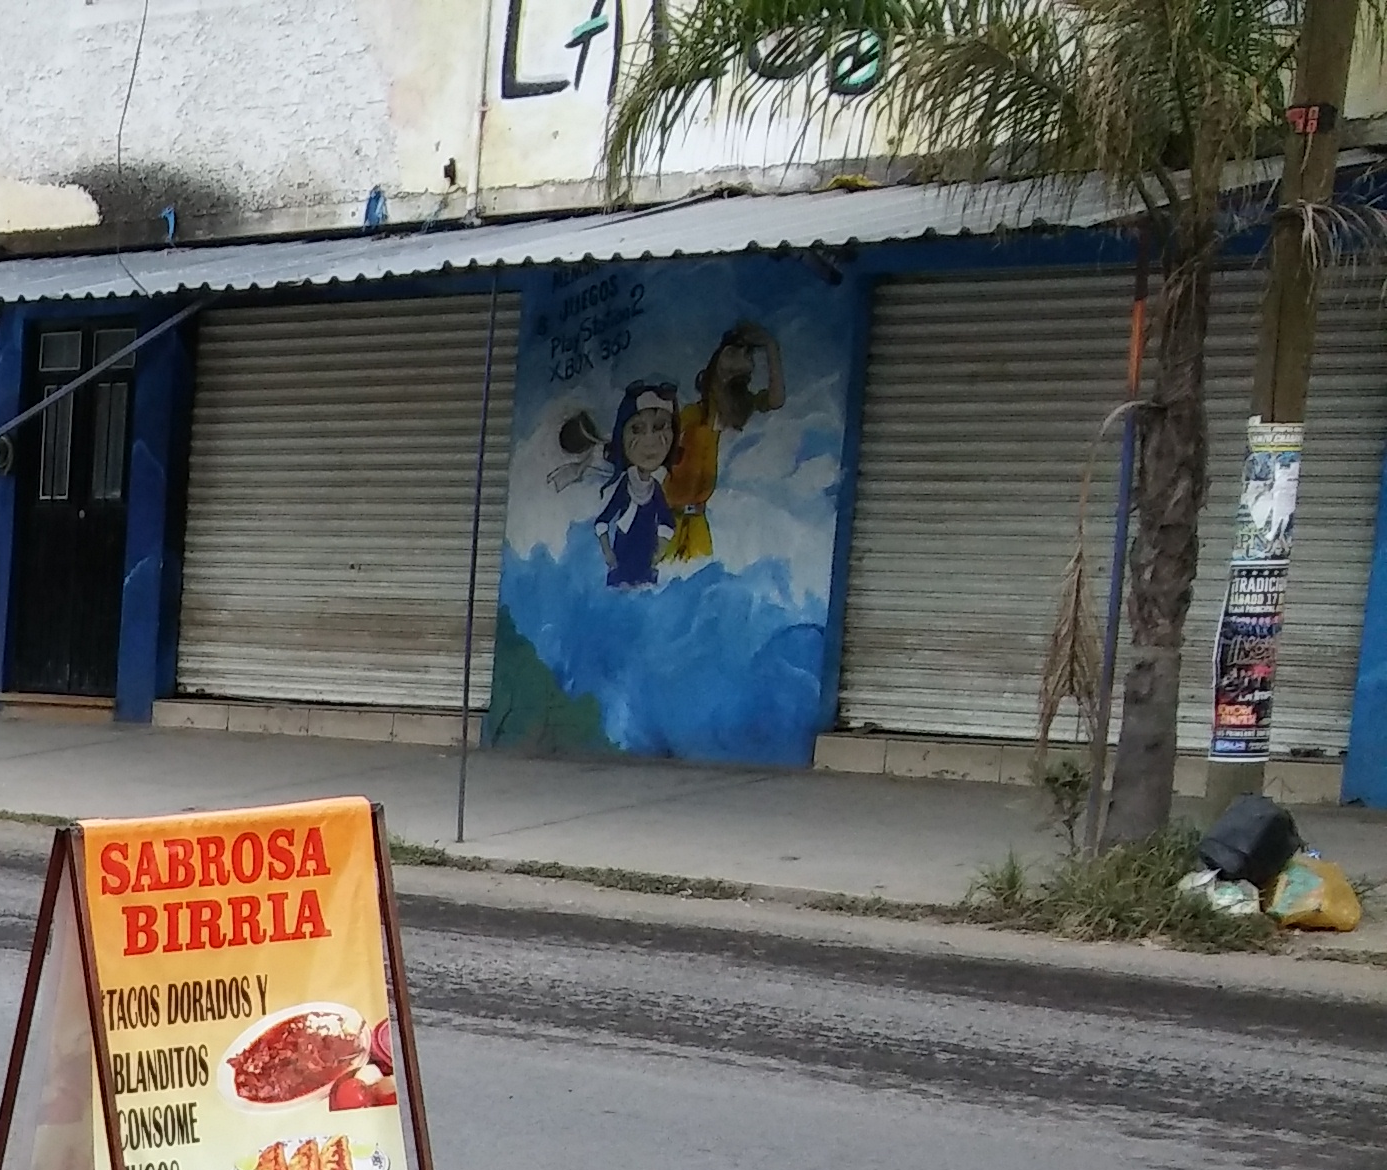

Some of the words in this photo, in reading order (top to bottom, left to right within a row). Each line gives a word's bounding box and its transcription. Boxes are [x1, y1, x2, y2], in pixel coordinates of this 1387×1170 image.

[559, 273, 619, 322] JUEGOS
[99, 826, 332, 896] SABROSA
[122, 889, 332, 957] BIRRIA
[166, 975, 253, 1026] DORADOS
[255, 974, 270, 1016] Y
[112, 1043, 210, 1095] BLANDITOS
[118, 1101, 201, 1152] CONSOME
